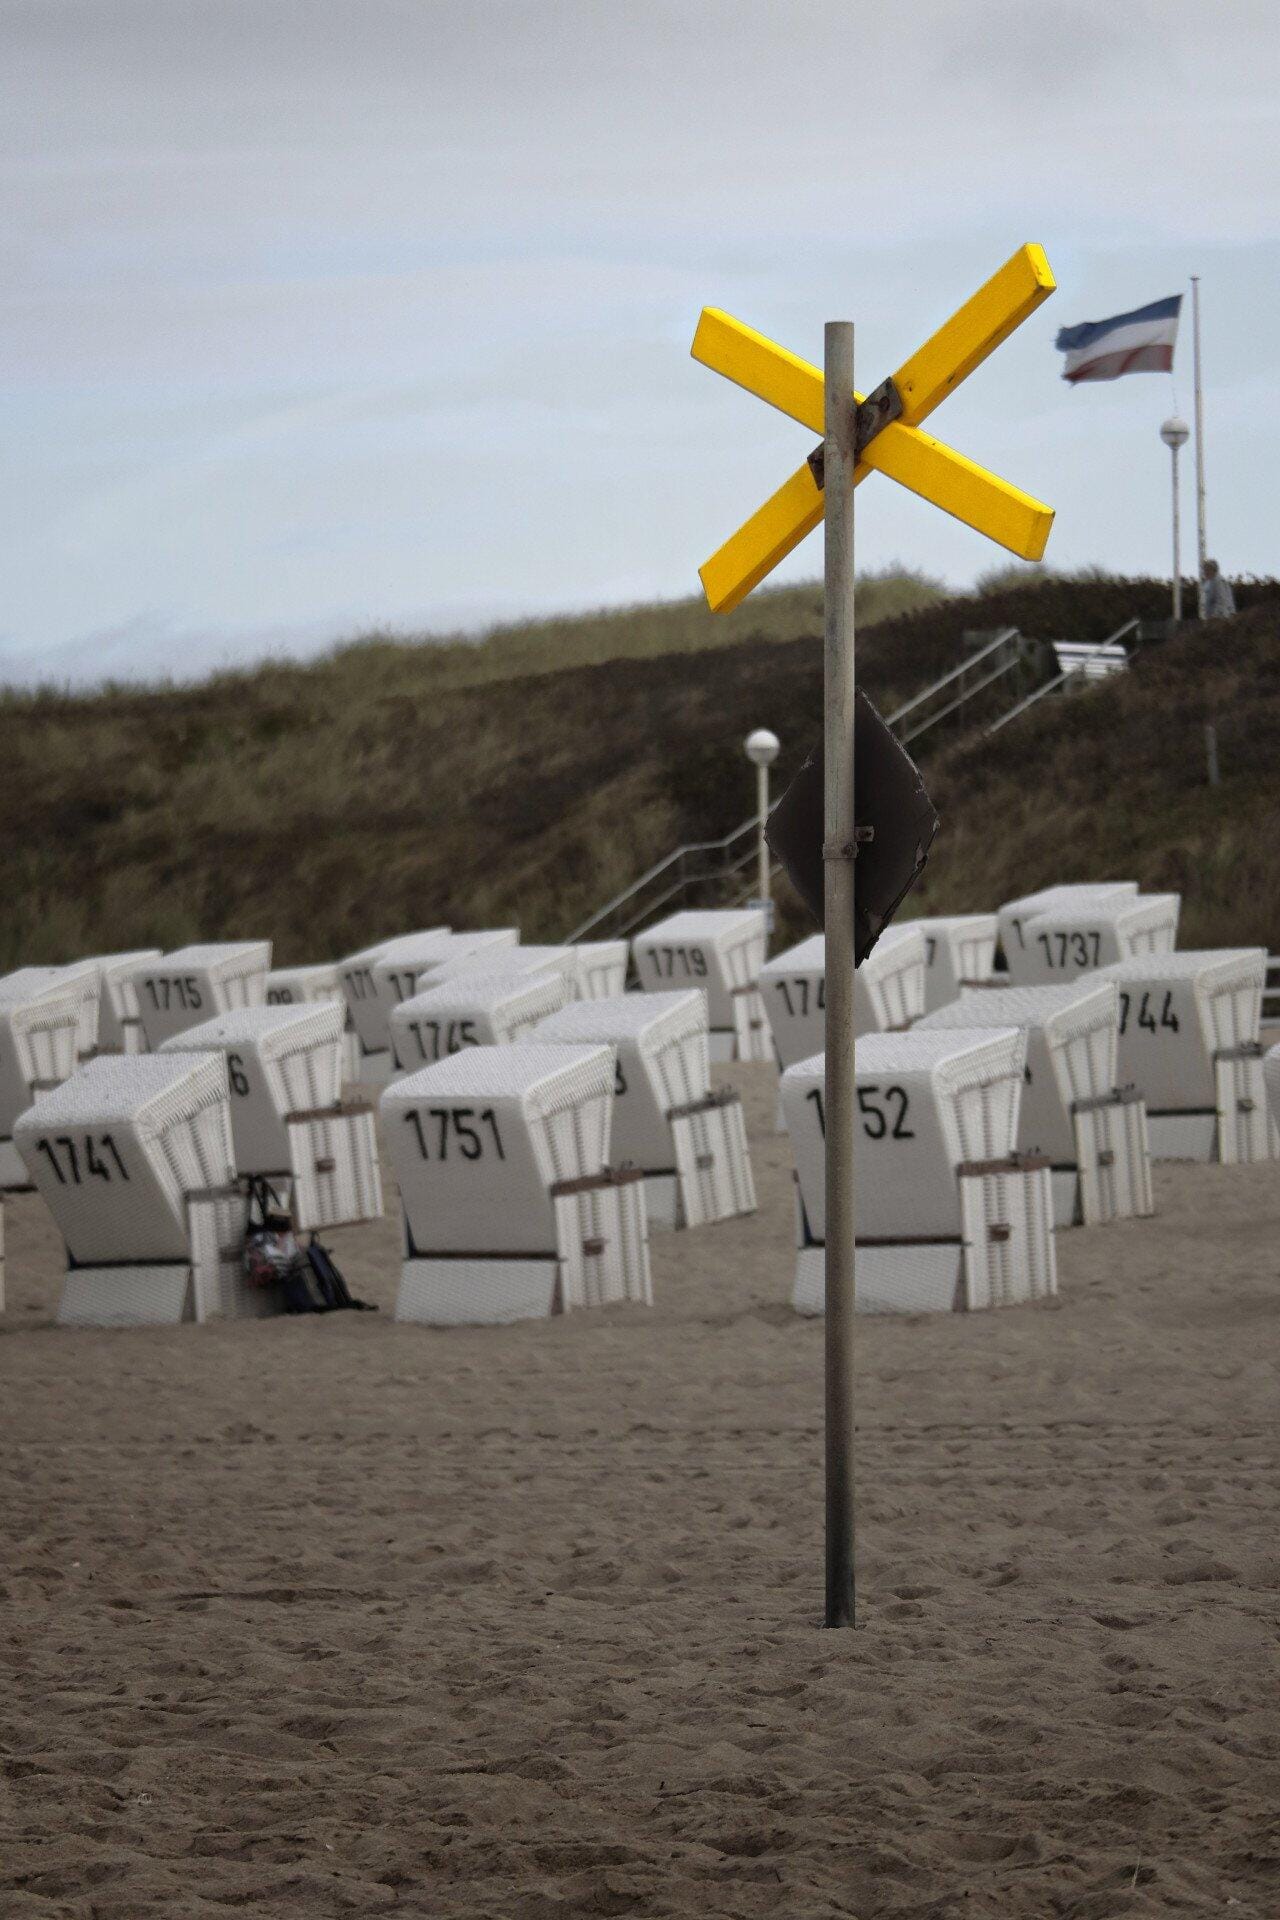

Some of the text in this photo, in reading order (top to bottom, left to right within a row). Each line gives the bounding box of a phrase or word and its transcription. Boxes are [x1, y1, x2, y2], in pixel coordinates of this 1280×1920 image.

[648, 948, 708, 977] 1719
[1037, 931, 1101, 968] 1737
[146, 977, 203, 1011] 1715
[409, 1020, 479, 1060] 1745
[806, 1085, 915, 1140] 152
[404, 1108, 506, 1162] 1751
[36, 1133, 131, 1185] 1741
